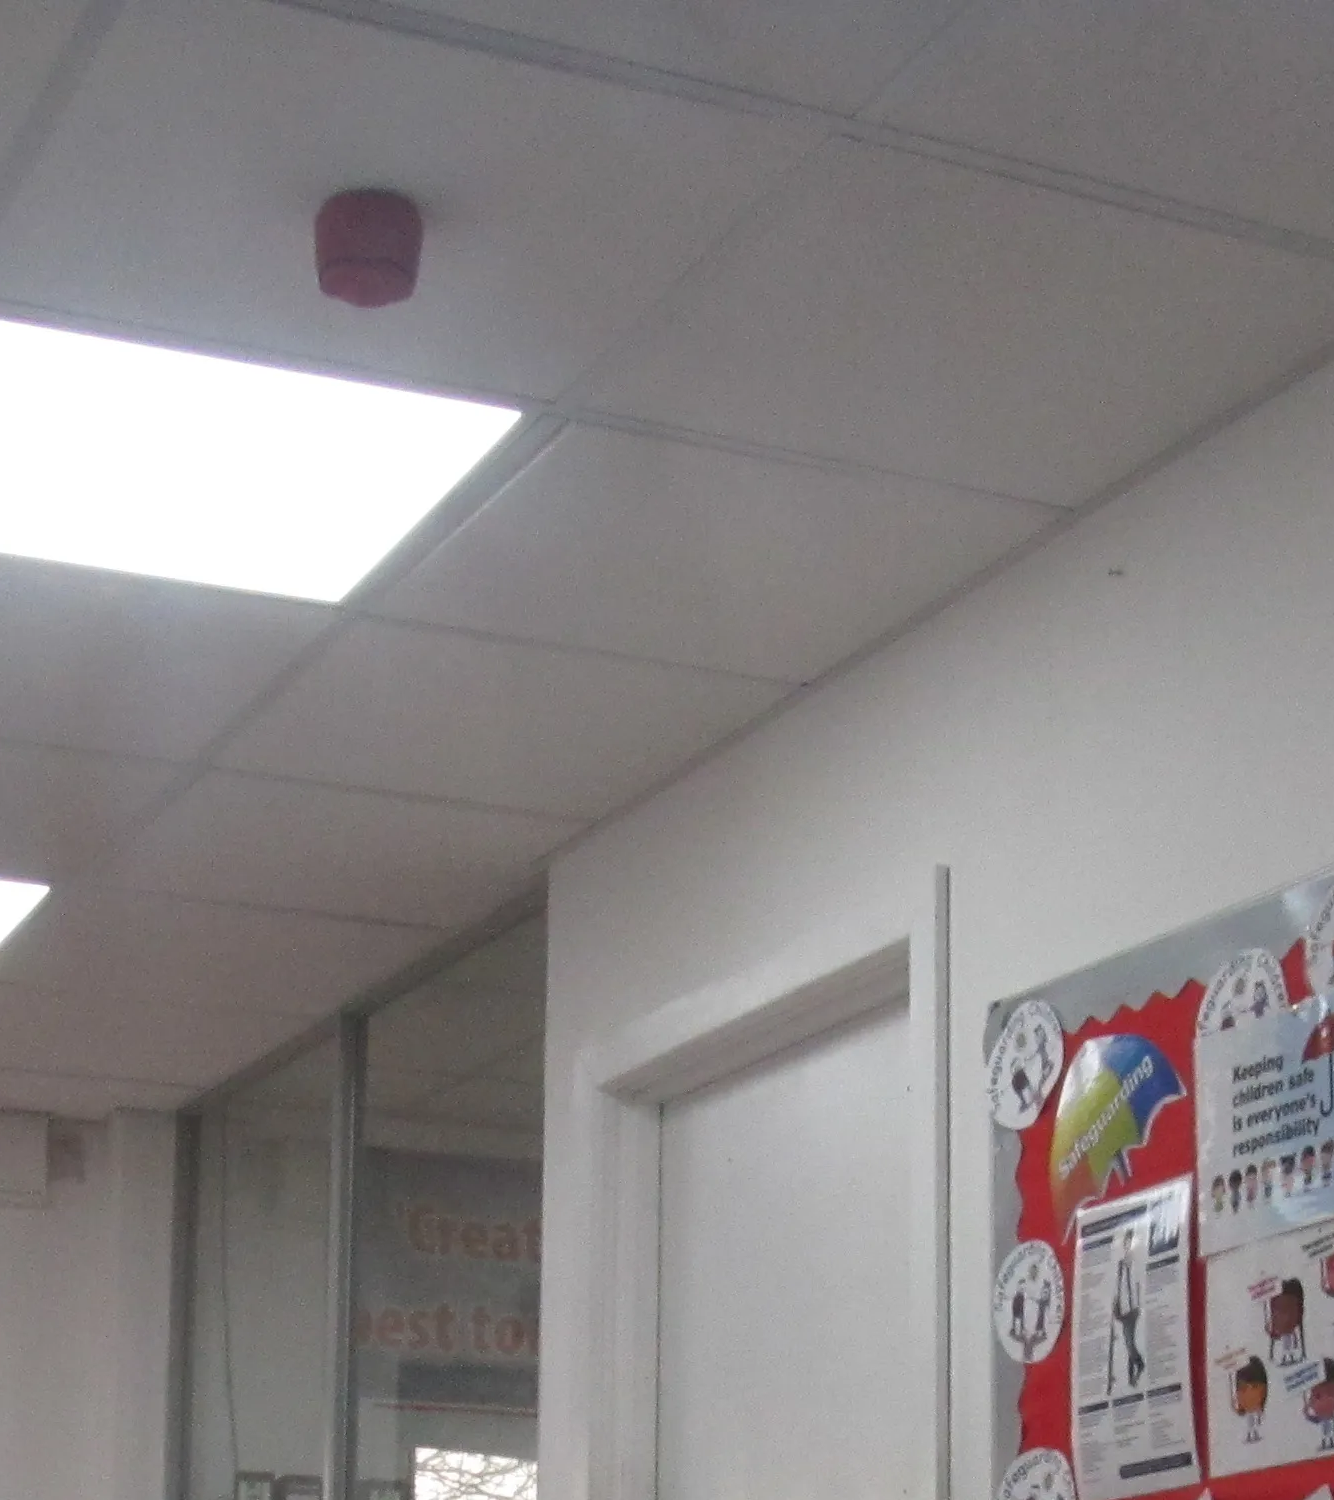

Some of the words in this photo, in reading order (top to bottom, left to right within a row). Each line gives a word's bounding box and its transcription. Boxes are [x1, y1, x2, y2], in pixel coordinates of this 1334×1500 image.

[1232, 1053, 1285, 1083] Keeping
[1232, 1078, 1289, 1109] children
[1289, 1067, 1315, 1089] safe
[1058, 1055, 1155, 1181] Safeguarding
[1232, 1116, 1243, 1133] is
[1246, 1093, 1317, 1128] everyone's
[1232, 1118, 1321, 1157] responsibility
